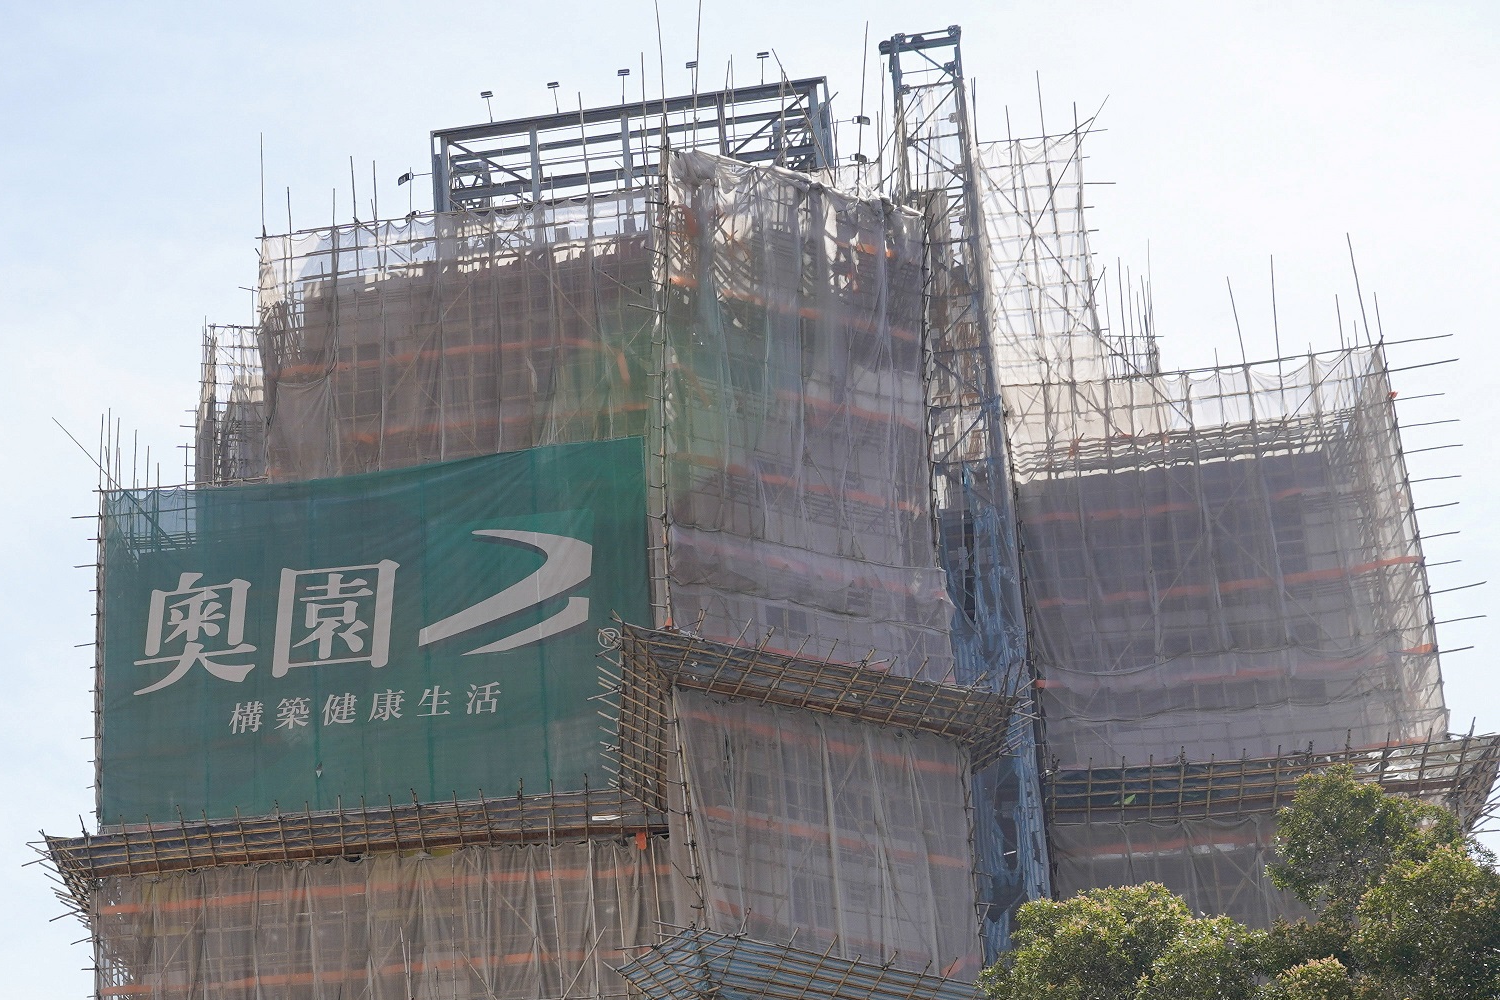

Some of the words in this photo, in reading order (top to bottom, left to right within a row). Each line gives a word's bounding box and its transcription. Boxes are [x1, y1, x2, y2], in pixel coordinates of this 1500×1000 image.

[133, 559, 401, 697] 奧園
[228, 681, 503, 735] 構築健康生活
